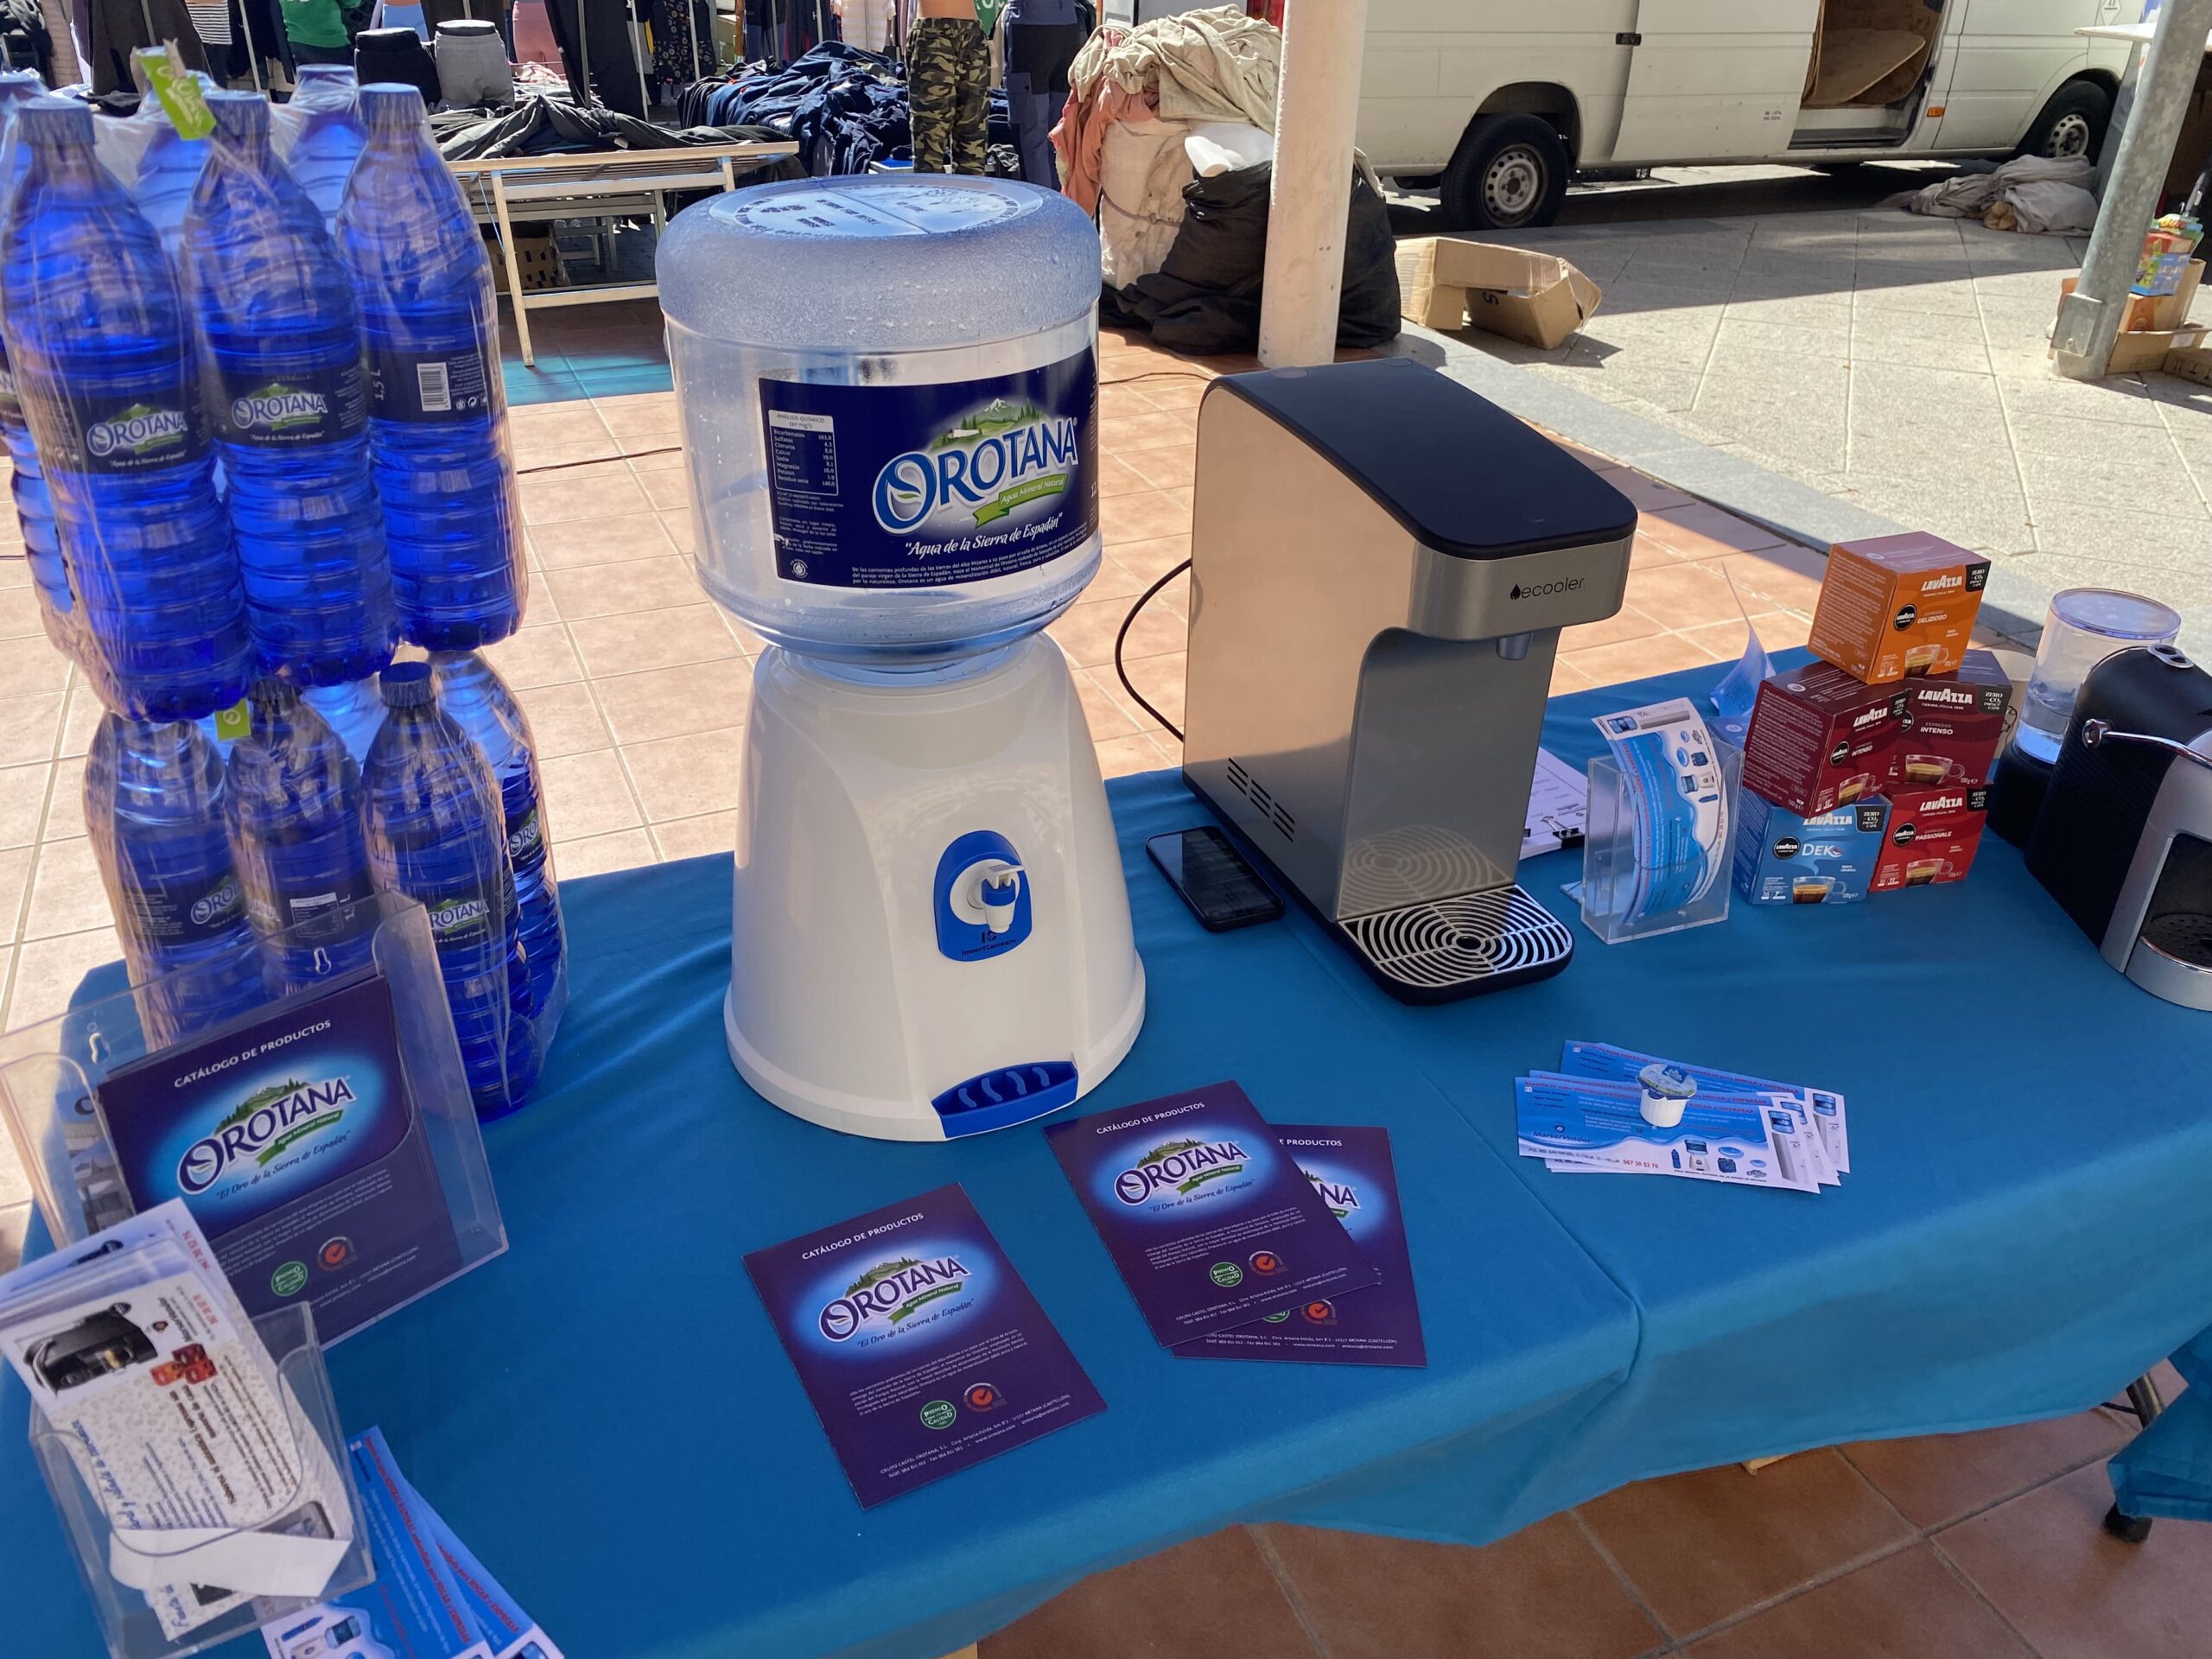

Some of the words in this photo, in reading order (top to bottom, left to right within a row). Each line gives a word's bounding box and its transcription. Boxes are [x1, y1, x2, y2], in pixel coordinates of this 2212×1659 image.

[232, 393, 328, 429] OROTANA
[87, 411, 188, 456] OROTANA
[874, 417, 1078, 534] OROTANA
[1001, 493, 1019, 505] Agua
[1020, 482, 1043, 498] Mineral
[1044, 478, 1065, 490] Natural
[944, 539, 957, 552] de
[960, 538, 970, 550] la
[972, 532, 1007, 549] Sierra
[1009, 528, 1021, 541] de
[1521, 576, 1585, 599] ecooler
[1921, 575, 1962, 592] LAVAZZA
[1918, 614, 1947, 624] DELIZIOSO
[1918, 689, 1973, 704] LAVAZZA
[1853, 708, 1888, 727] LAVAZZA
[1852, 745, 1872, 757] INTENSO
[1920, 797, 1962, 811] LAVAZZA
[1803, 812, 1853, 826] LAVAZZA
[1915, 831, 1952, 841] PASSIONALE
[1802, 843, 1834, 856] DEK
[428, 900, 490, 929] ROTANA
[175, 1055, 238, 1088] CATÁLOGO
[242, 1049, 257, 1060] DE
[261, 1020, 331, 1052] PRODUCTOS
[1096, 1118, 1141, 1135] CATÁLOGO
[1154, 1102, 1205, 1121] PRODUCTOS
[178, 1076, 357, 1194] OROTANA
[1533, 1131, 1591, 1143] MarserVendor
[232, 1182, 248, 1193] Oro
[251, 1174, 261, 1185] de
[264, 1167, 270, 1179] la
[272, 1158, 299, 1174] Sierra
[302, 1151, 311, 1161] de
[1115, 1141, 1253, 1205] OROTANA
[1161, 1202, 1175, 1211] Oro
[1177, 1198, 1185, 1207] de
[1194, 1192, 1215, 1202] Sierra
[802, 1237, 852, 1260] CATÁLOGO
[854, 1232, 867, 1242] DE
[868, 1213, 924, 1236] PRODUCTOS
[1213, 1266, 1235, 1276] PREMIO
[1217, 1273, 1239, 1283] CALIDAD
[819, 1255, 972, 1342] OROTANA
[871, 1333, 886, 1344] Oro
[887, 1329, 896, 1338] de
[898, 1325, 905, 1333] la
[906, 1317, 931, 1331] Sierra
[931, 1313, 940, 1321] de
[924, 1405, 948, 1417] PREMIO
[928, 1412, 953, 1425] CALIDAD
